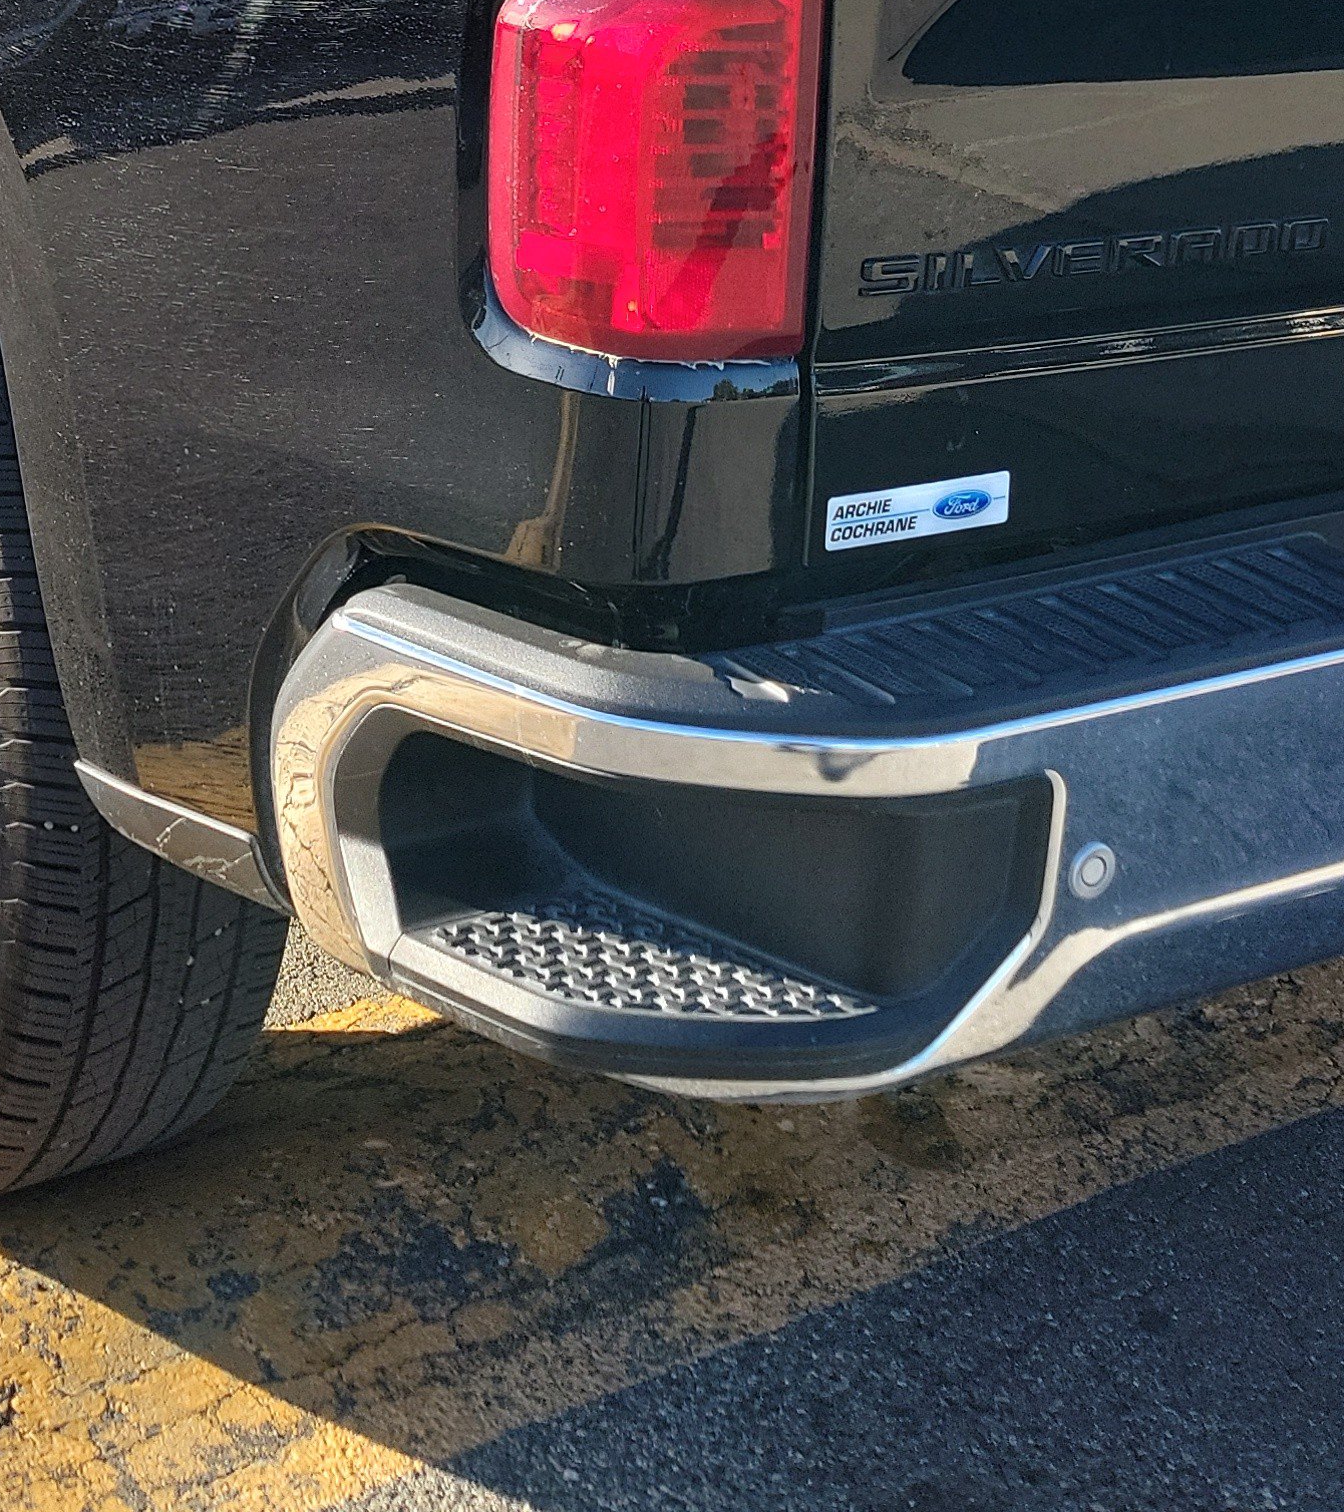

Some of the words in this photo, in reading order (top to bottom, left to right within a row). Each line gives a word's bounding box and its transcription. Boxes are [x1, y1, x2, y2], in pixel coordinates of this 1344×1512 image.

[858, 217, 1329, 297] SILVERADO
[831, 498, 893, 521] ARCHIE
[943, 493, 982, 516] Ford
[830, 515, 918, 543] COCHRANE
